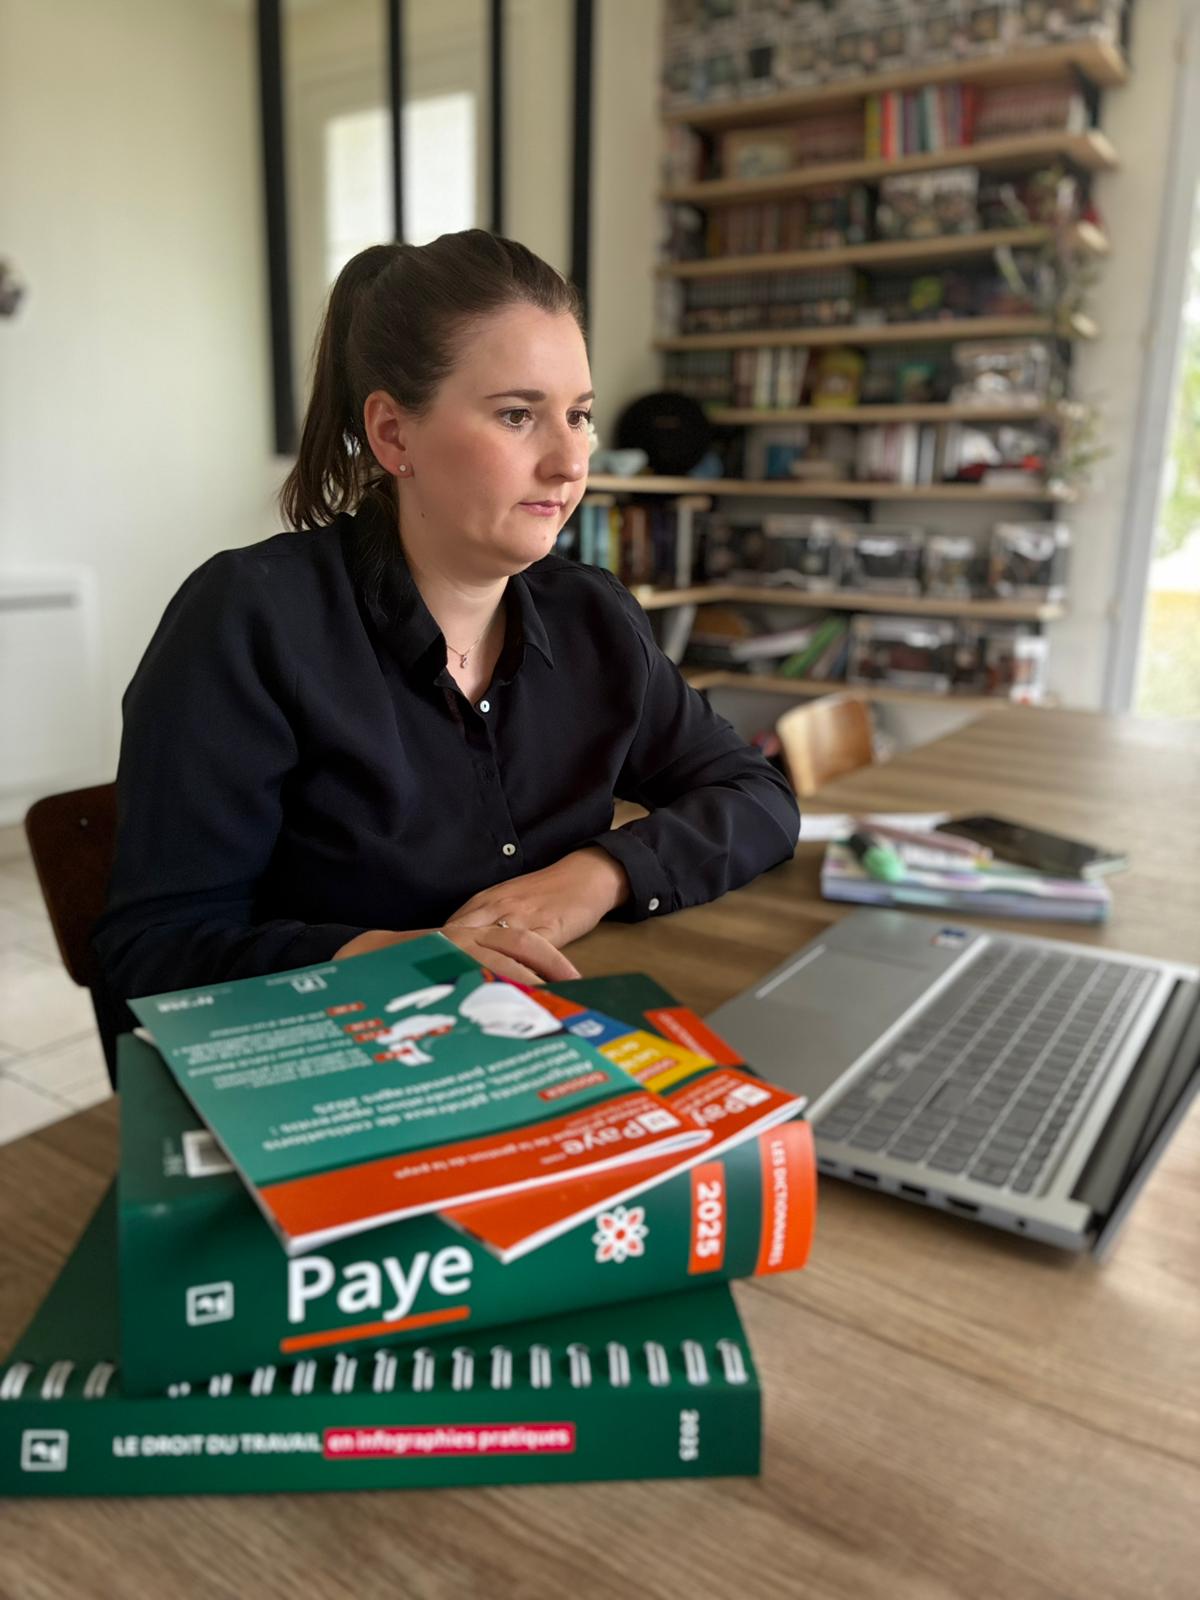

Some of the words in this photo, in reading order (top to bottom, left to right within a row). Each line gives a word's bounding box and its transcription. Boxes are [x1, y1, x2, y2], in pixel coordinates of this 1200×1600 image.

[376, 1115, 401, 1127] de
[690, 1096, 748, 1127] Pay
[561, 1120, 648, 1155] Paye
[770, 1140, 786, 1166] LES
[697, 1180, 722, 1258] 2025
[768, 1167, 788, 1266] DICTIONNAIRES
[288, 1246, 473, 1323] Paye
[112, 1436, 139, 1457] LE
[141, 1434, 205, 1457] DROIT
[206, 1434, 239, 1455] DU
[240, 1432, 323, 1453] TRAVAIL
[327, 1434, 354, 1451] en
[355, 1429, 475, 1454] infographies
[477, 1427, 570, 1451] pratiques
[679, 1409, 699, 1461] 2025
